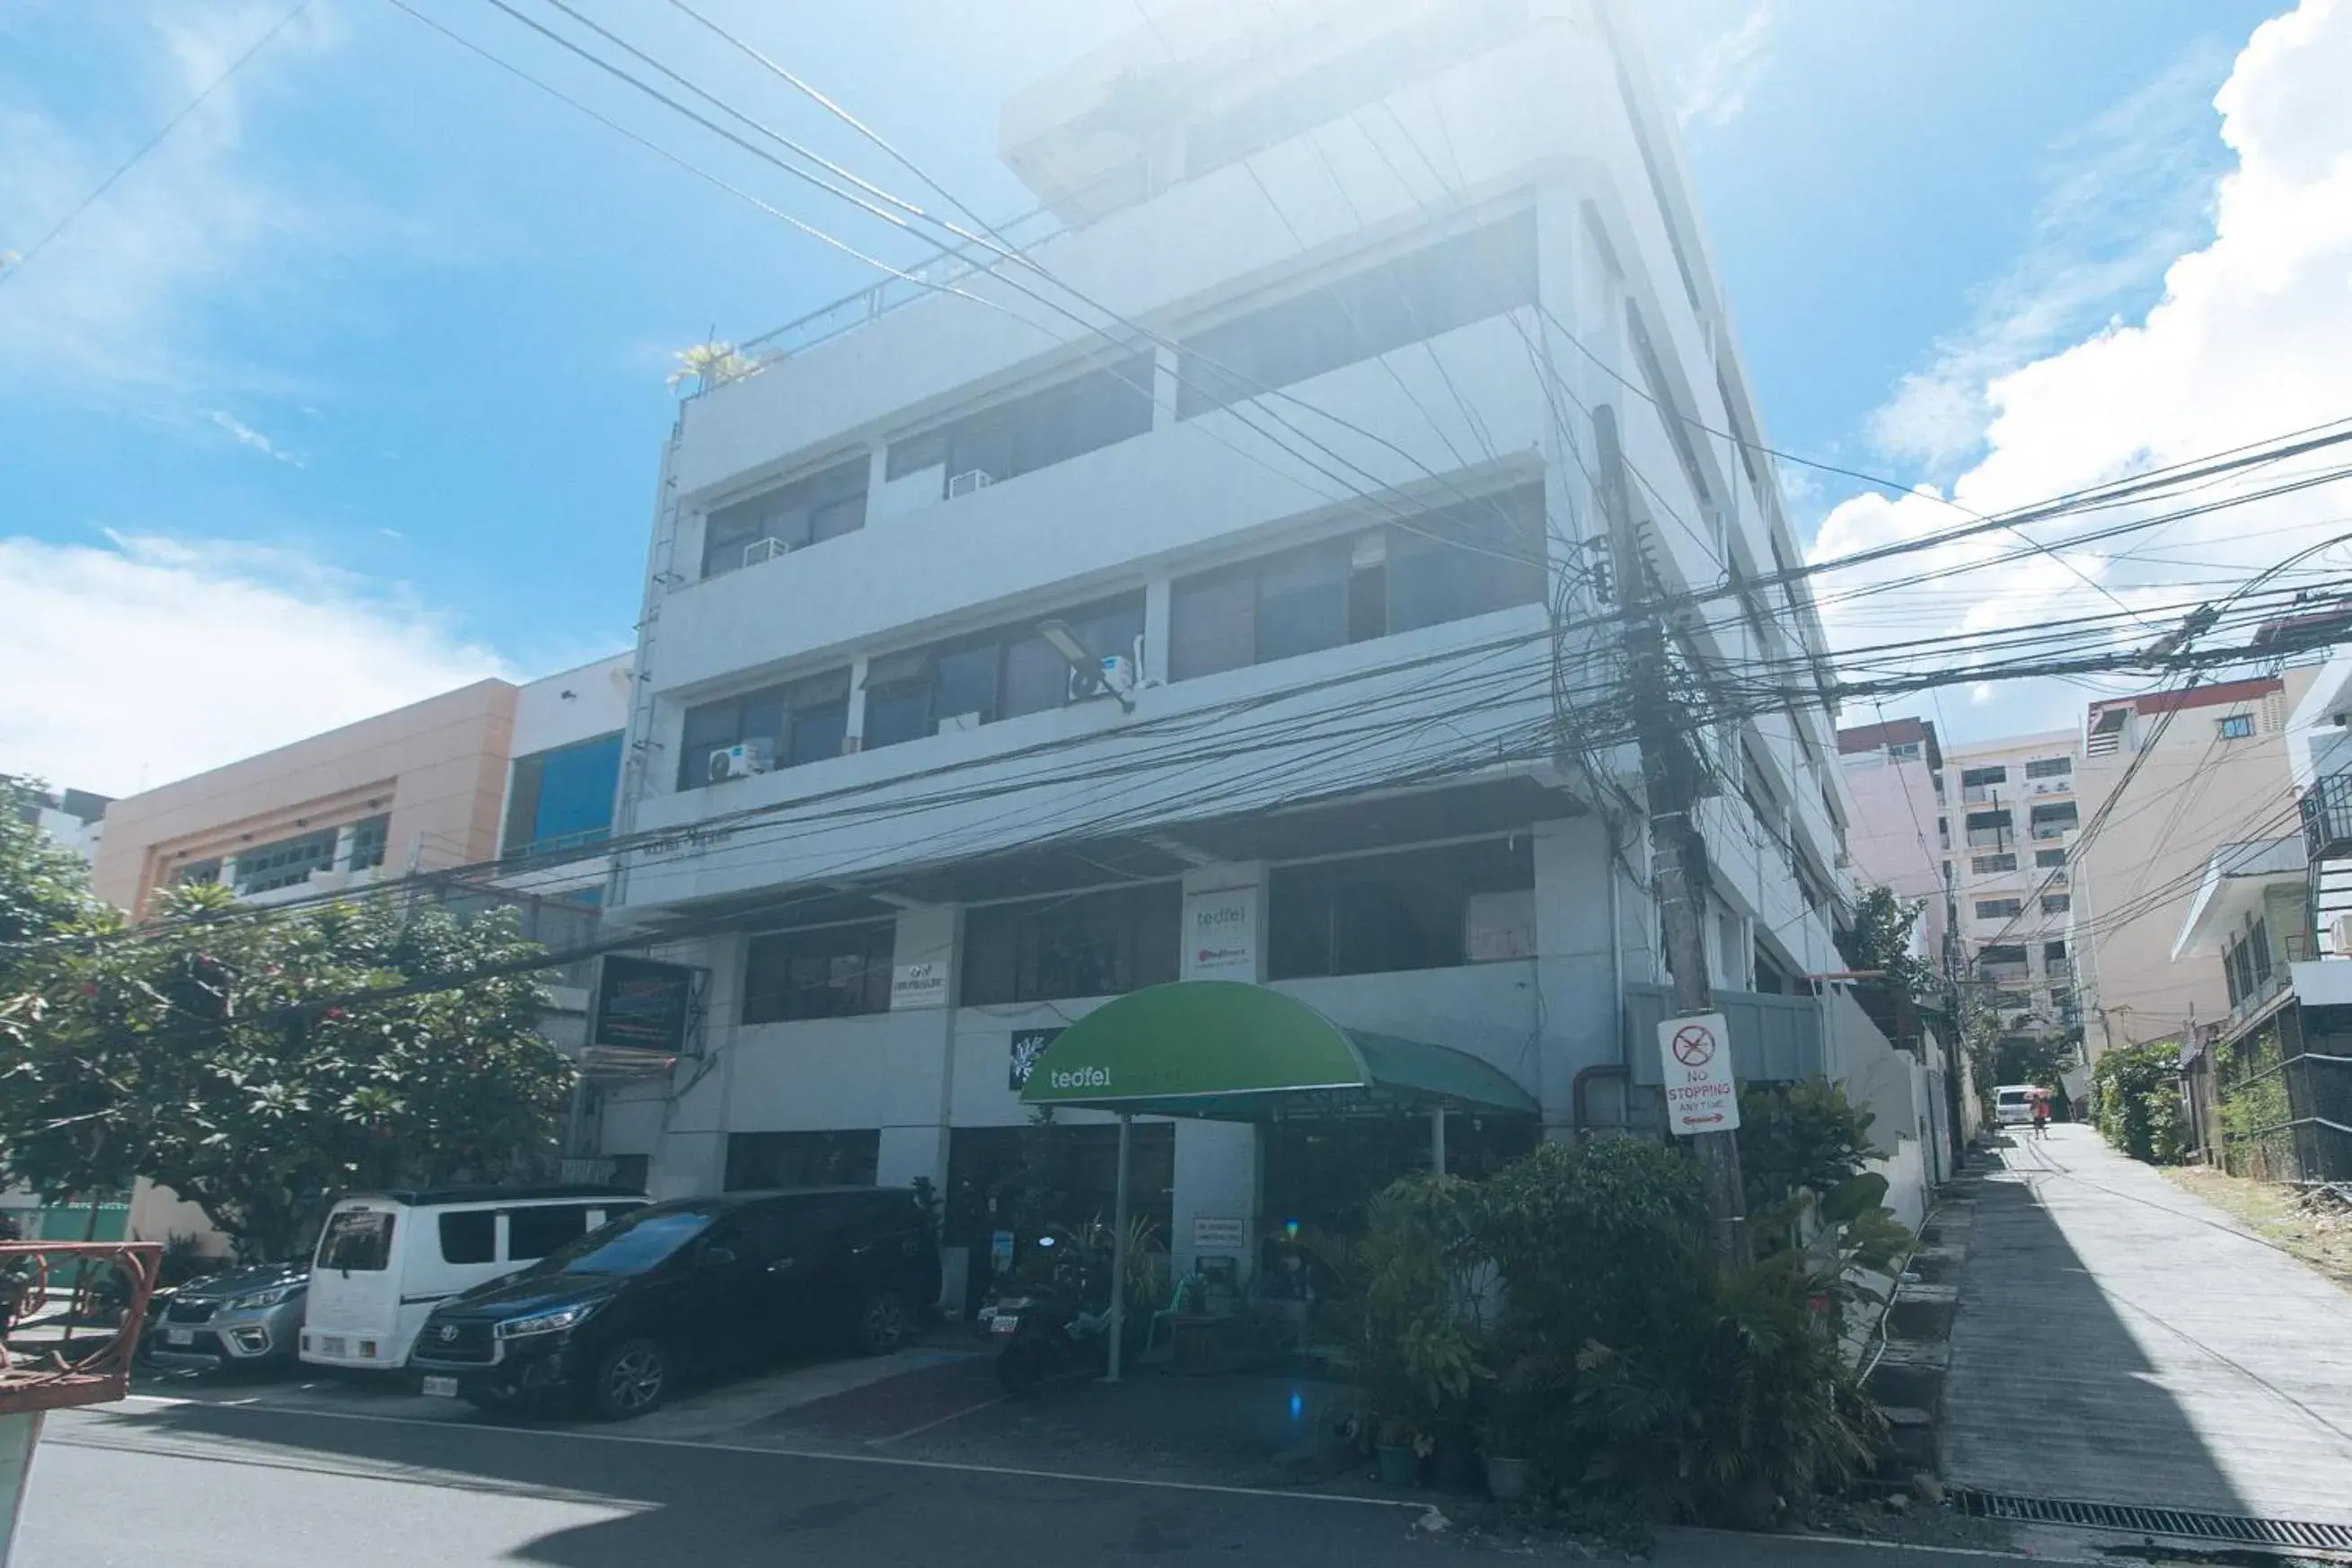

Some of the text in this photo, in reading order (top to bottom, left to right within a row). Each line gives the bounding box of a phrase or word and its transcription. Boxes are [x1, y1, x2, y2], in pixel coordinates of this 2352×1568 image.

[1196, 905, 1246, 926] tedfel
[1051, 1066, 1112, 1088] tedfel
[1687, 1070, 1707, 1082] NO
[1669, 1083, 1730, 1101] STOPPING
